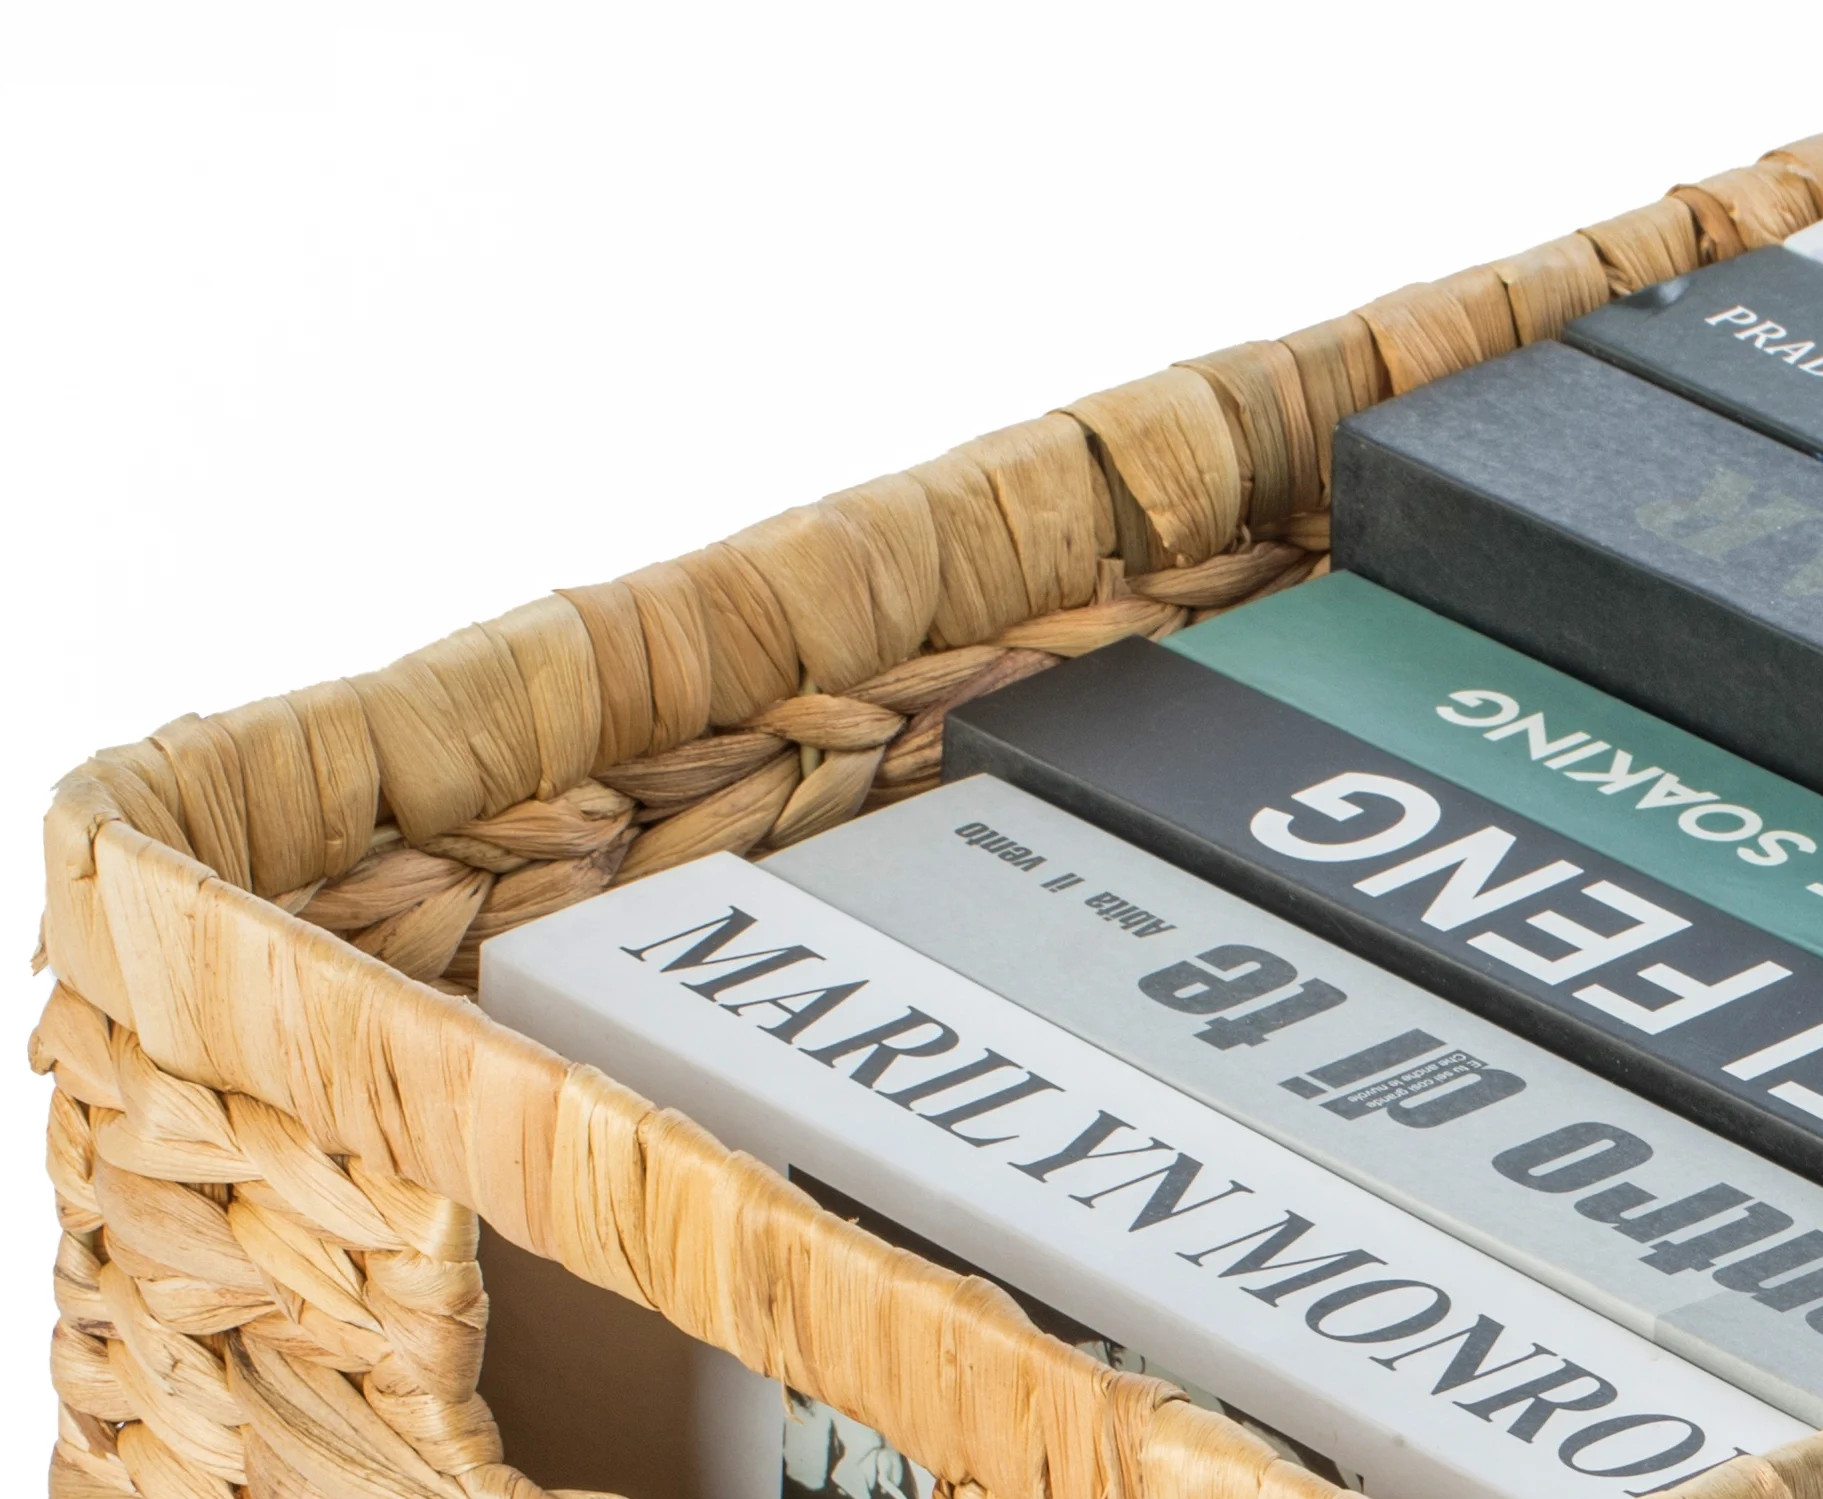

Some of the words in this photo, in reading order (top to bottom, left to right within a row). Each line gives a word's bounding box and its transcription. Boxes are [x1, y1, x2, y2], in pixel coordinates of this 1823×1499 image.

[1436, 690, 1818, 866] SOAKING
[955, 822, 1047, 872] vento
[1041, 872, 1085, 891] il
[1085, 891, 1177, 938] Abita
[1250, 772, 1793, 1036] FENG
[1138, 944, 1348, 1051] te
[1278, 1028, 1527, 1129] di
[1438, 1052, 1467, 1067] Che
[619, 905, 1255, 1232] MARILYN
[1175, 1209, 1753, 1499] MONRO
